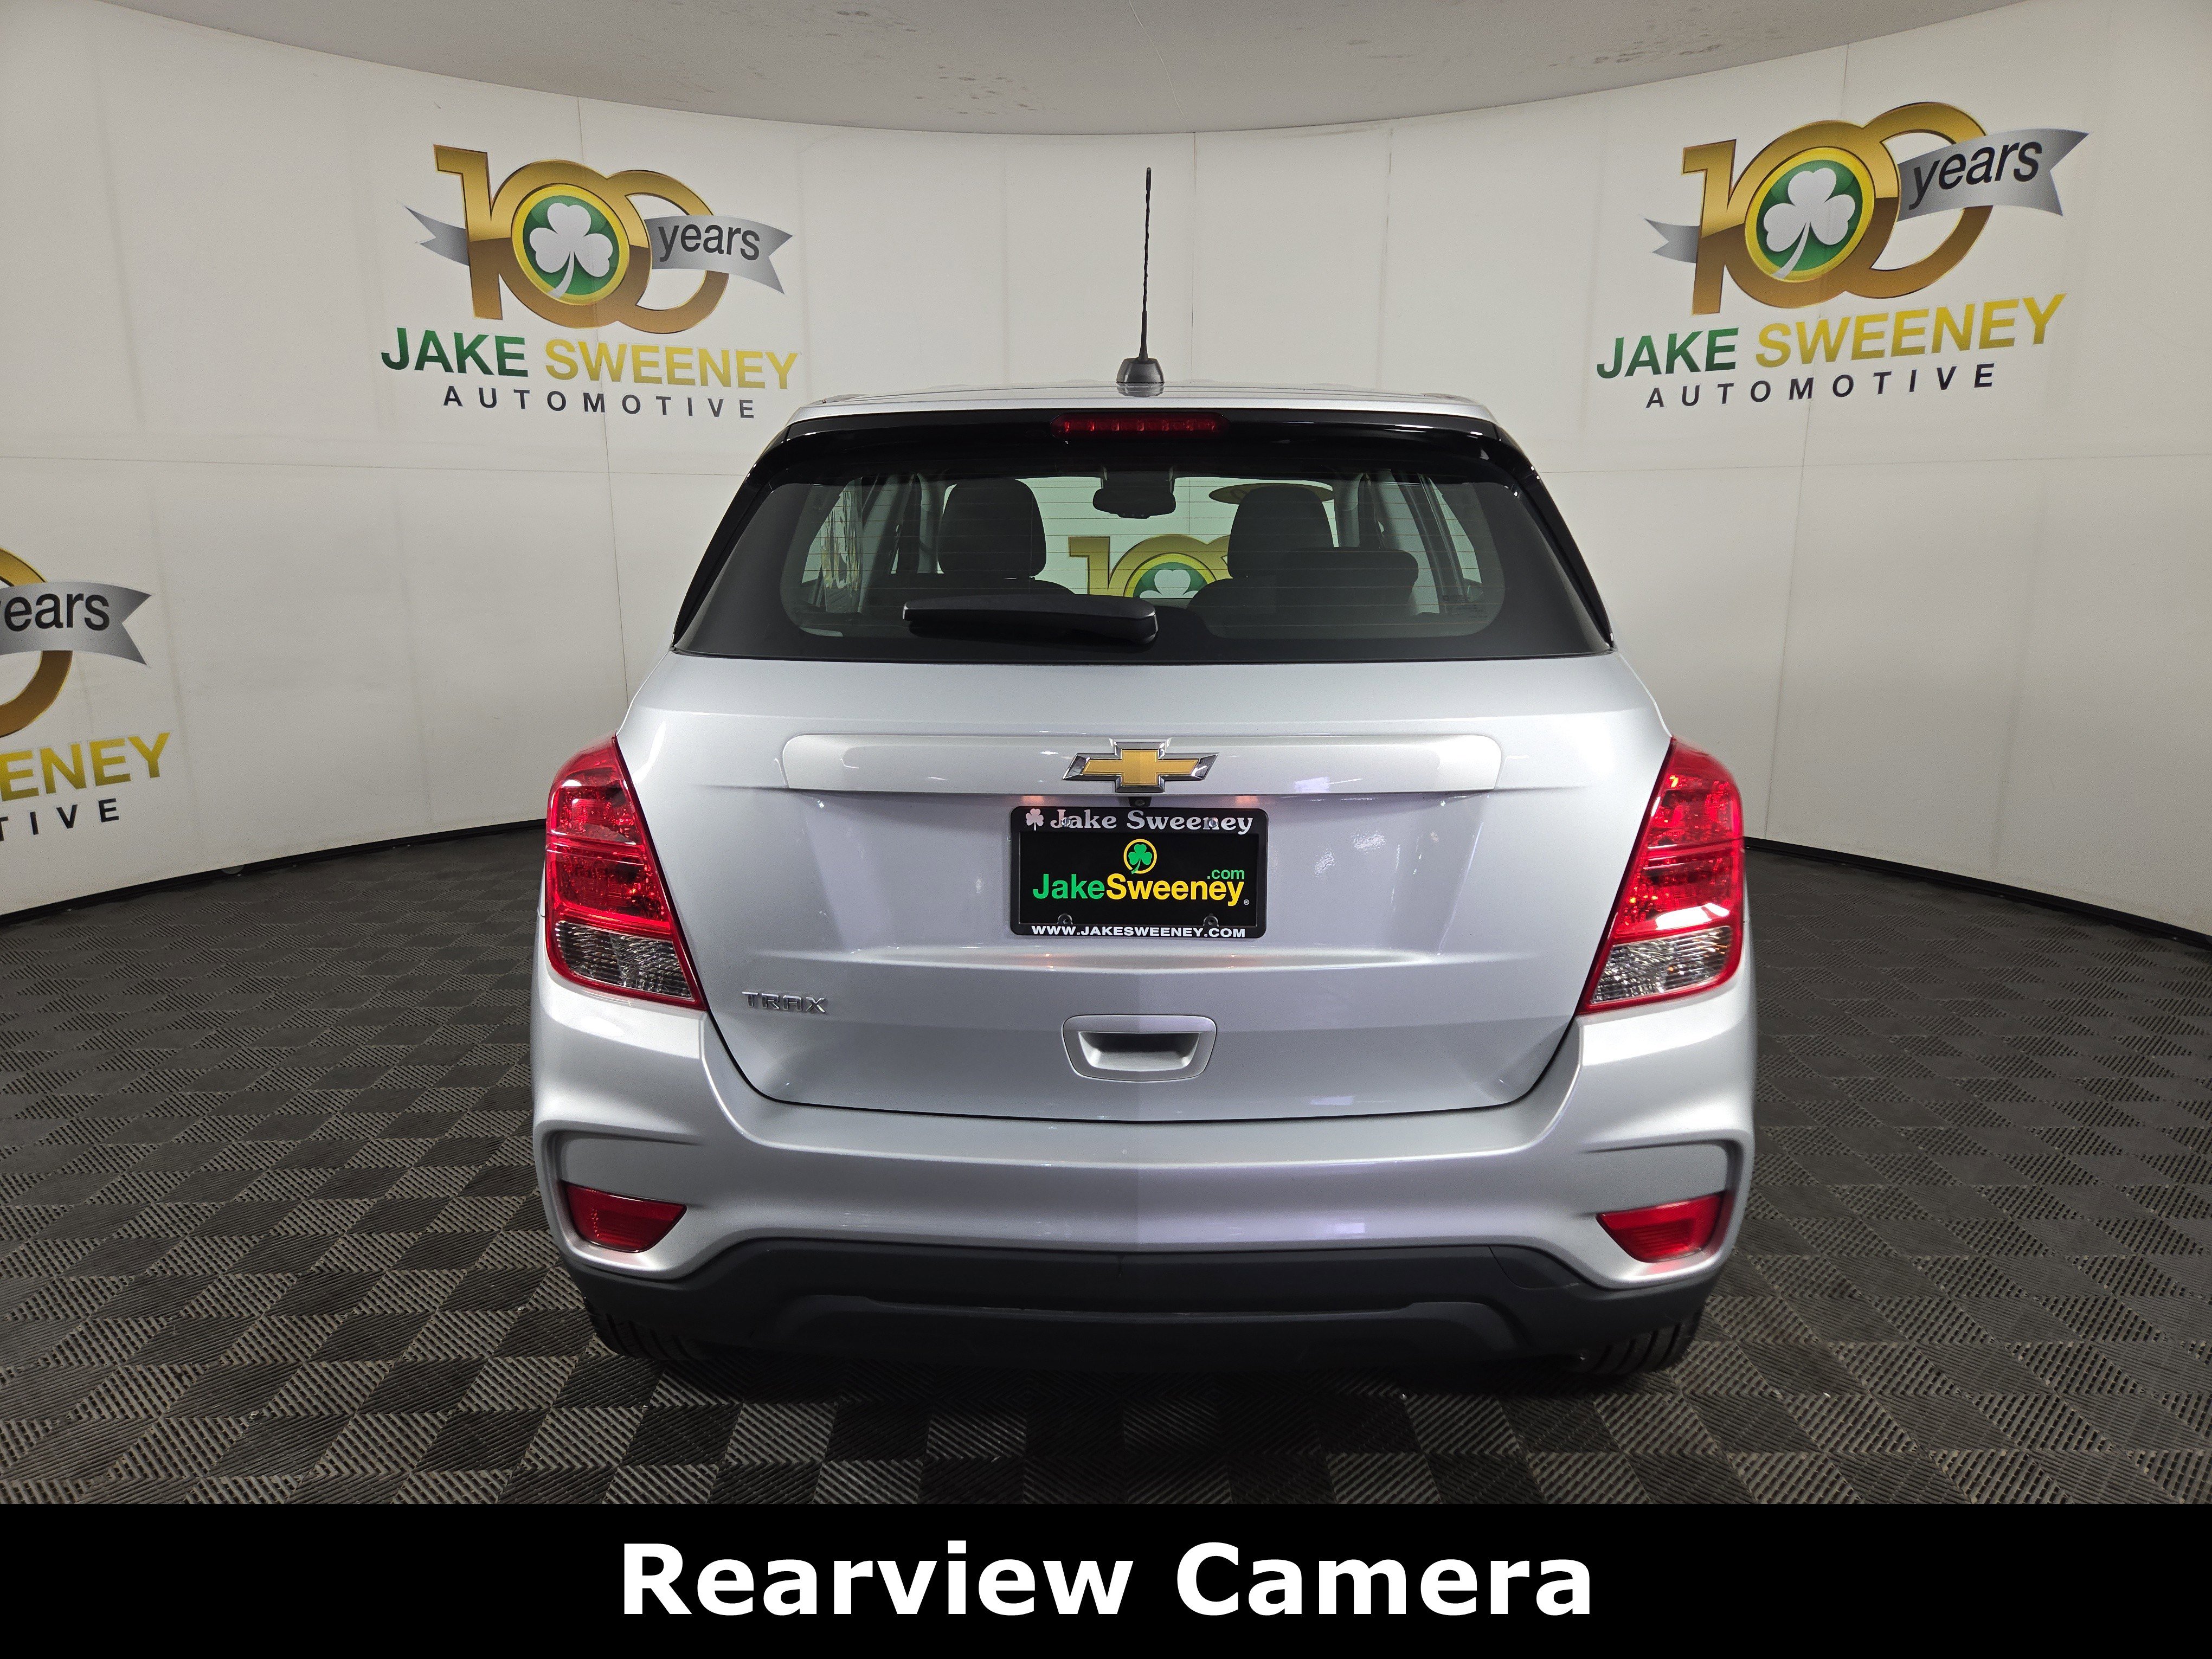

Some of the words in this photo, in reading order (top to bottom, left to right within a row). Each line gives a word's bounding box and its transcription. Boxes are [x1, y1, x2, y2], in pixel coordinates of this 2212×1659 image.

[1683, 101, 1994, 316] 100
[1908, 141, 2043, 210] years
[433, 144, 730, 334] 100
[658, 223, 761, 262] years
[1596, 327, 1739, 379] JAKE
[1756, 293, 2066, 368] SWEENEY
[381, 327, 529, 377] JAKE
[545, 338, 799, 390] SWEENEY
[443, 385, 755, 419] AUTOMOTIVE
[1645, 363, 1996, 409] AUTOMOTIVE
[0, 592, 110, 632] ears
[1050, 808, 1117, 829] Jake
[1127, 809, 1253, 835] Sweeney
[1032, 925, 1246, 938] WWW.JAKESWEENEY.COM
[742, 991, 826, 1013] TRAX
